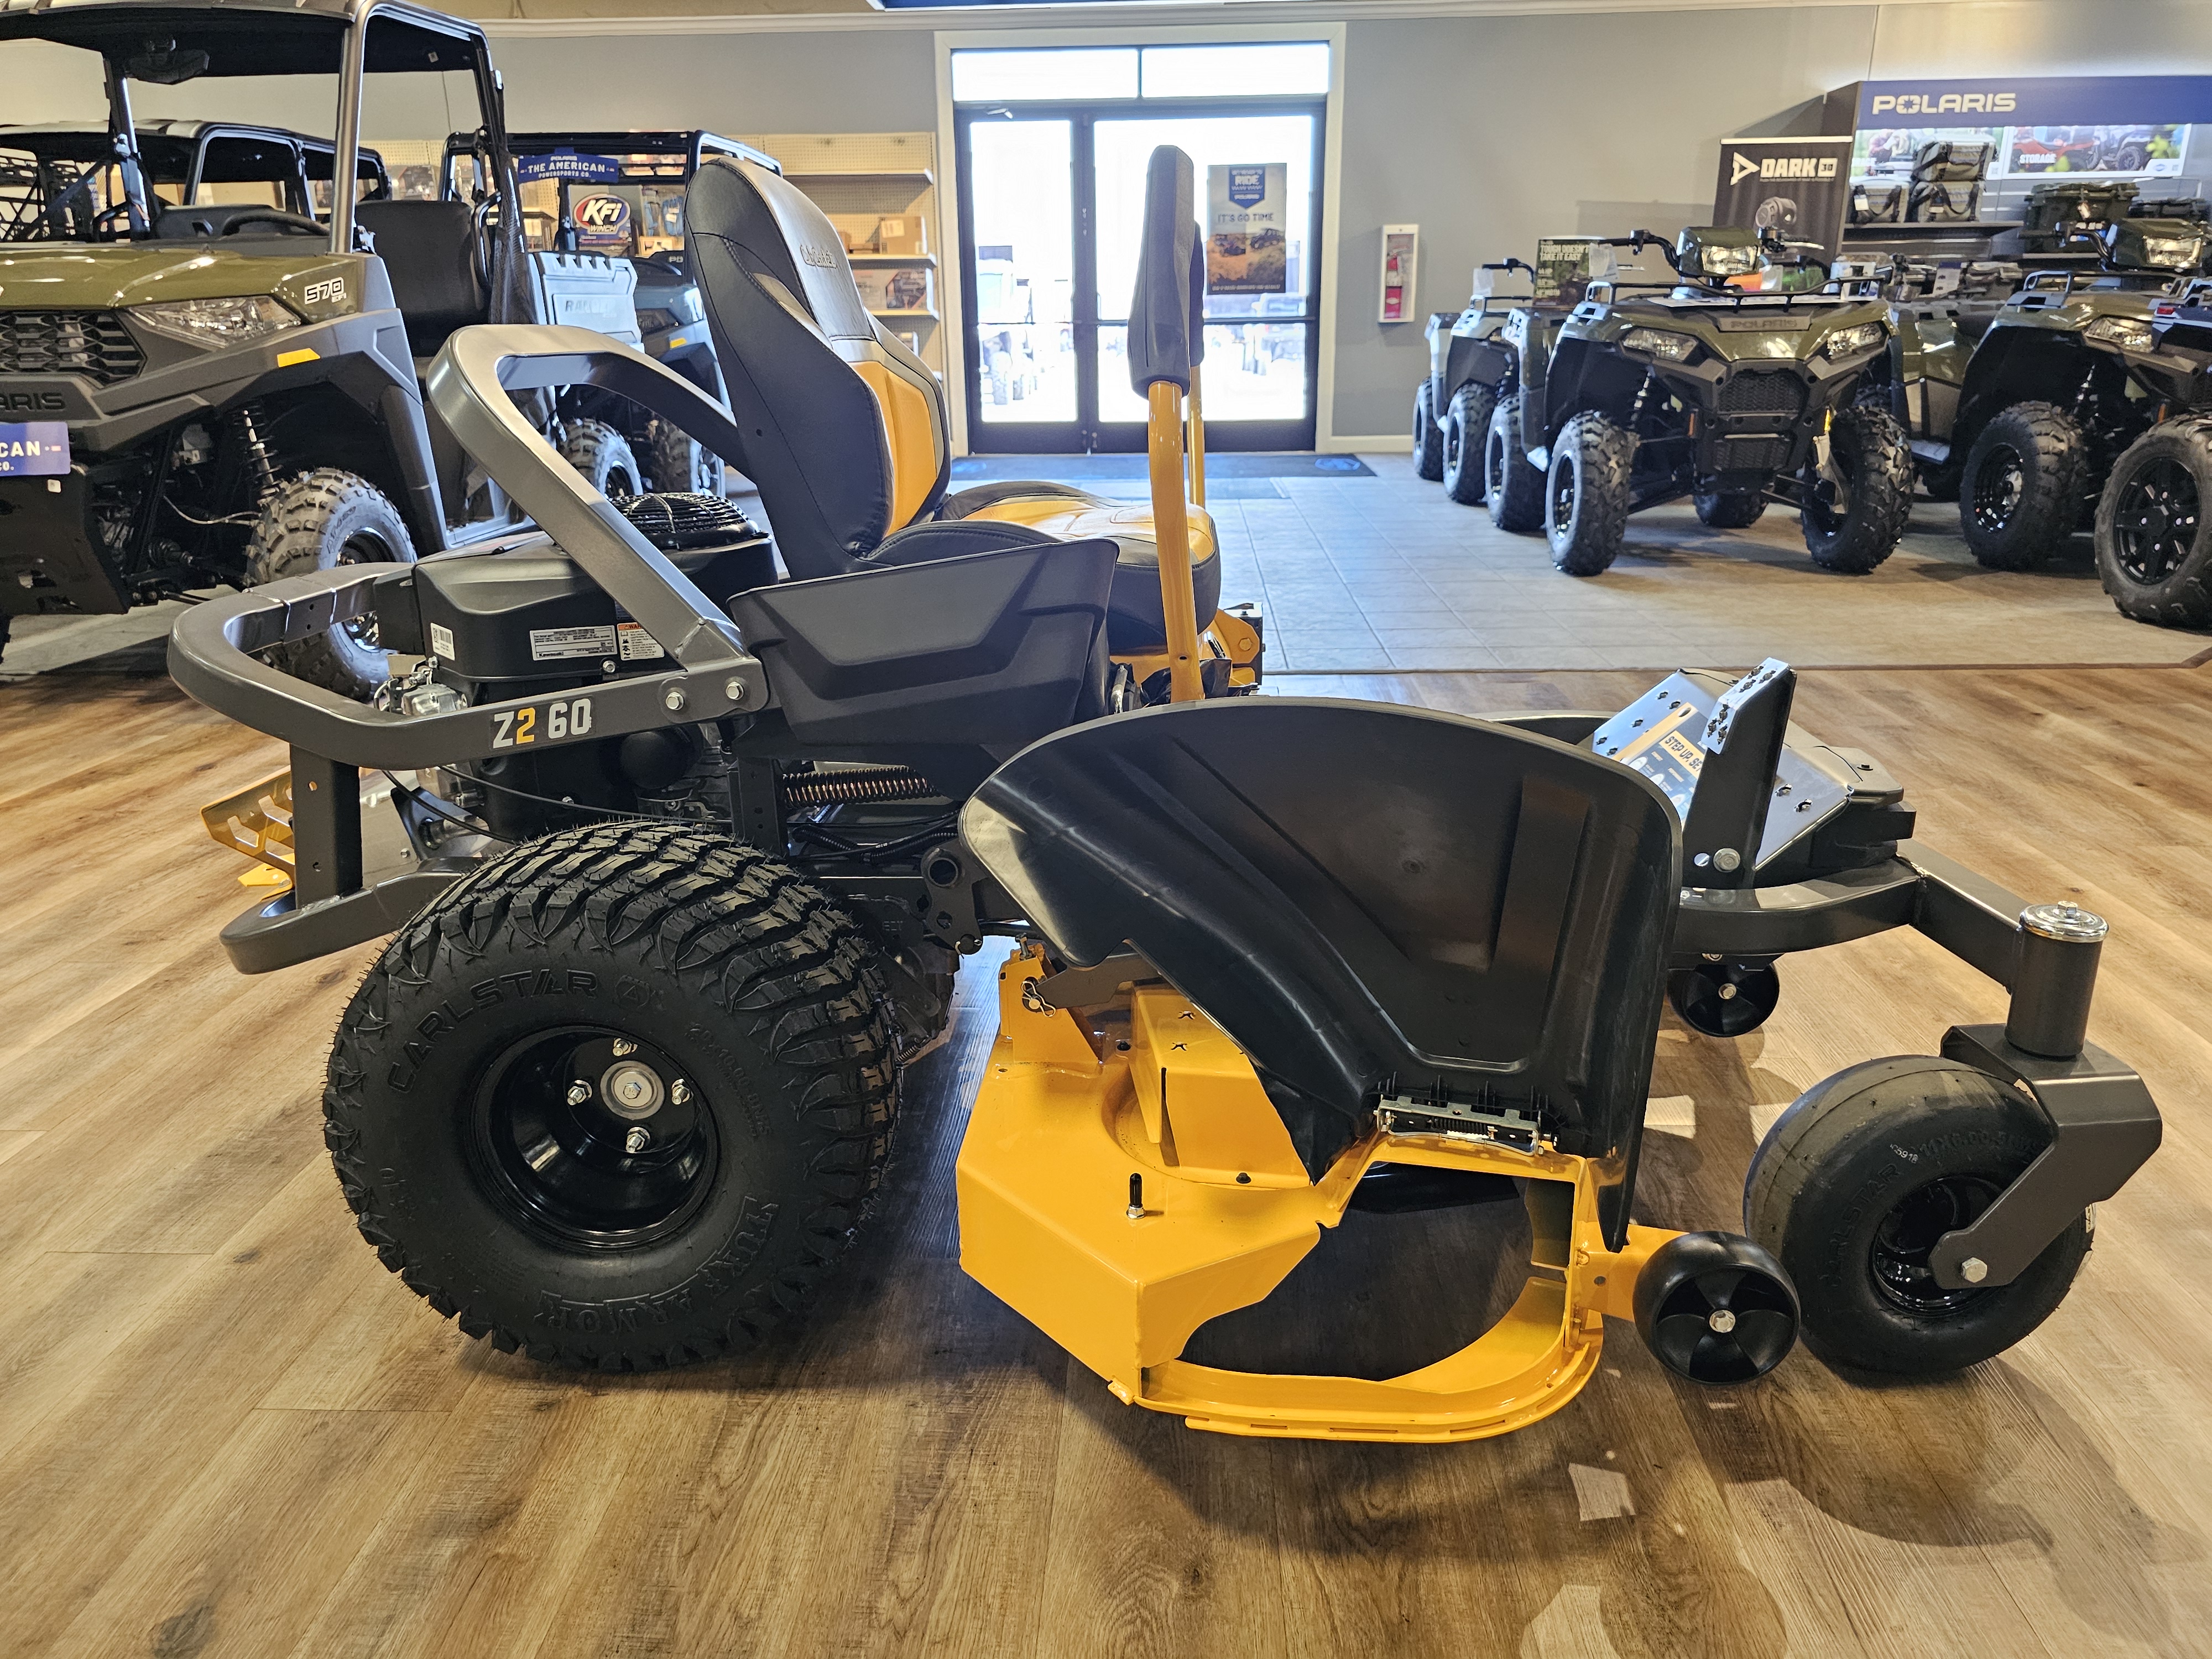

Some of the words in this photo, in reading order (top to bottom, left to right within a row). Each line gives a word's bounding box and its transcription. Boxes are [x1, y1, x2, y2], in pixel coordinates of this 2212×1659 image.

[1872, 93, 2016, 114] POLARIS
[2020, 154, 2057, 164] STORAGE
[528, 163, 546, 174] THE
[549, 161, 605, 173] AMERICAN
[1760, 158, 1818, 178] DARK
[1234, 175, 1260, 185] RIDE
[1218, 213, 1235, 222] IT'S
[1238, 213, 1250, 222] GO
[1253, 213, 1274, 222] TIME
[1540, 244, 1562, 253] TOUGH
[305, 277, 344, 305] 570
[1730, 320, 1797, 328] POLARIS
[0, 461, 14, 471] O.
[493, 707, 536, 749] Z2
[548, 698, 591, 739] 60
[1665, 736, 1685, 754] STEP
[387, 968, 598, 1094] CARLSTAR
[533, 1277, 693, 1337] ARMOR
